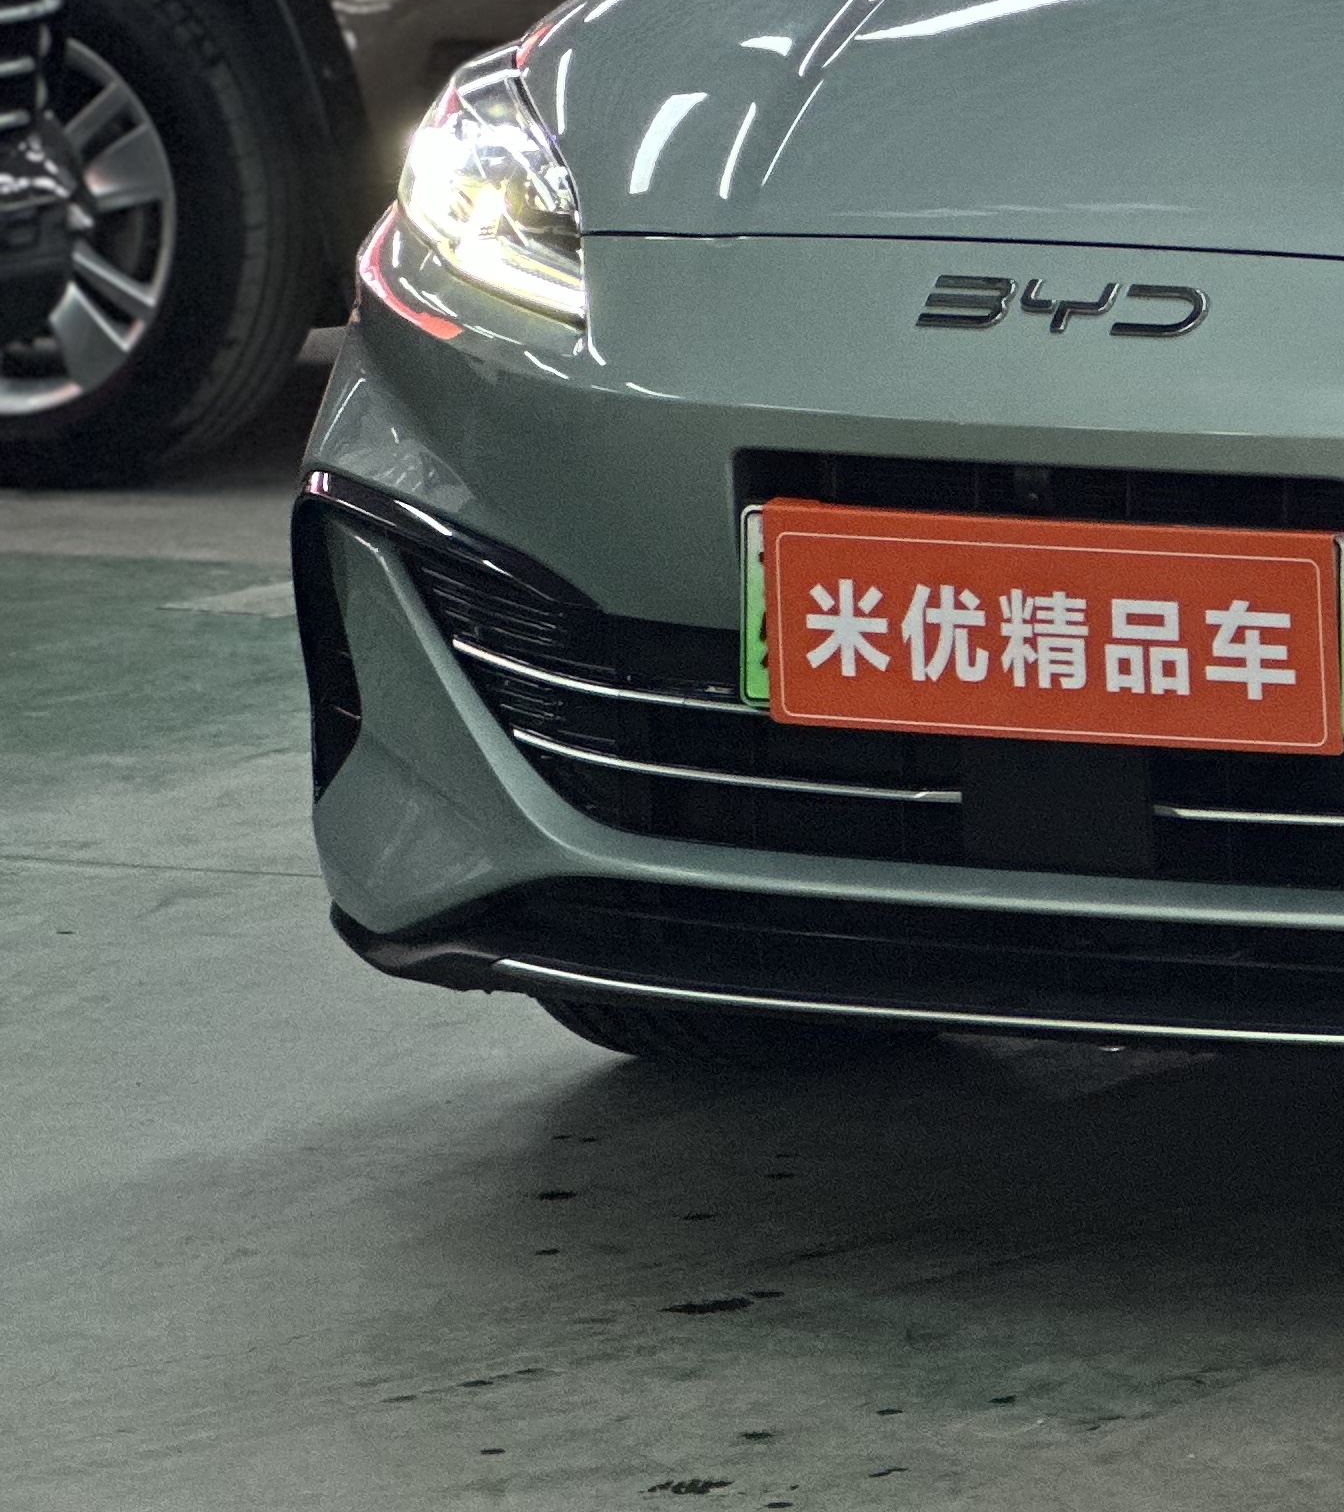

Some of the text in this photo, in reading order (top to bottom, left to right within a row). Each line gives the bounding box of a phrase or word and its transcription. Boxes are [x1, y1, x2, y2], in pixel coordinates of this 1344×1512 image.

[915, 274, 1211, 337] BYD
[804, 577, 1297, 701] 米优精品车
